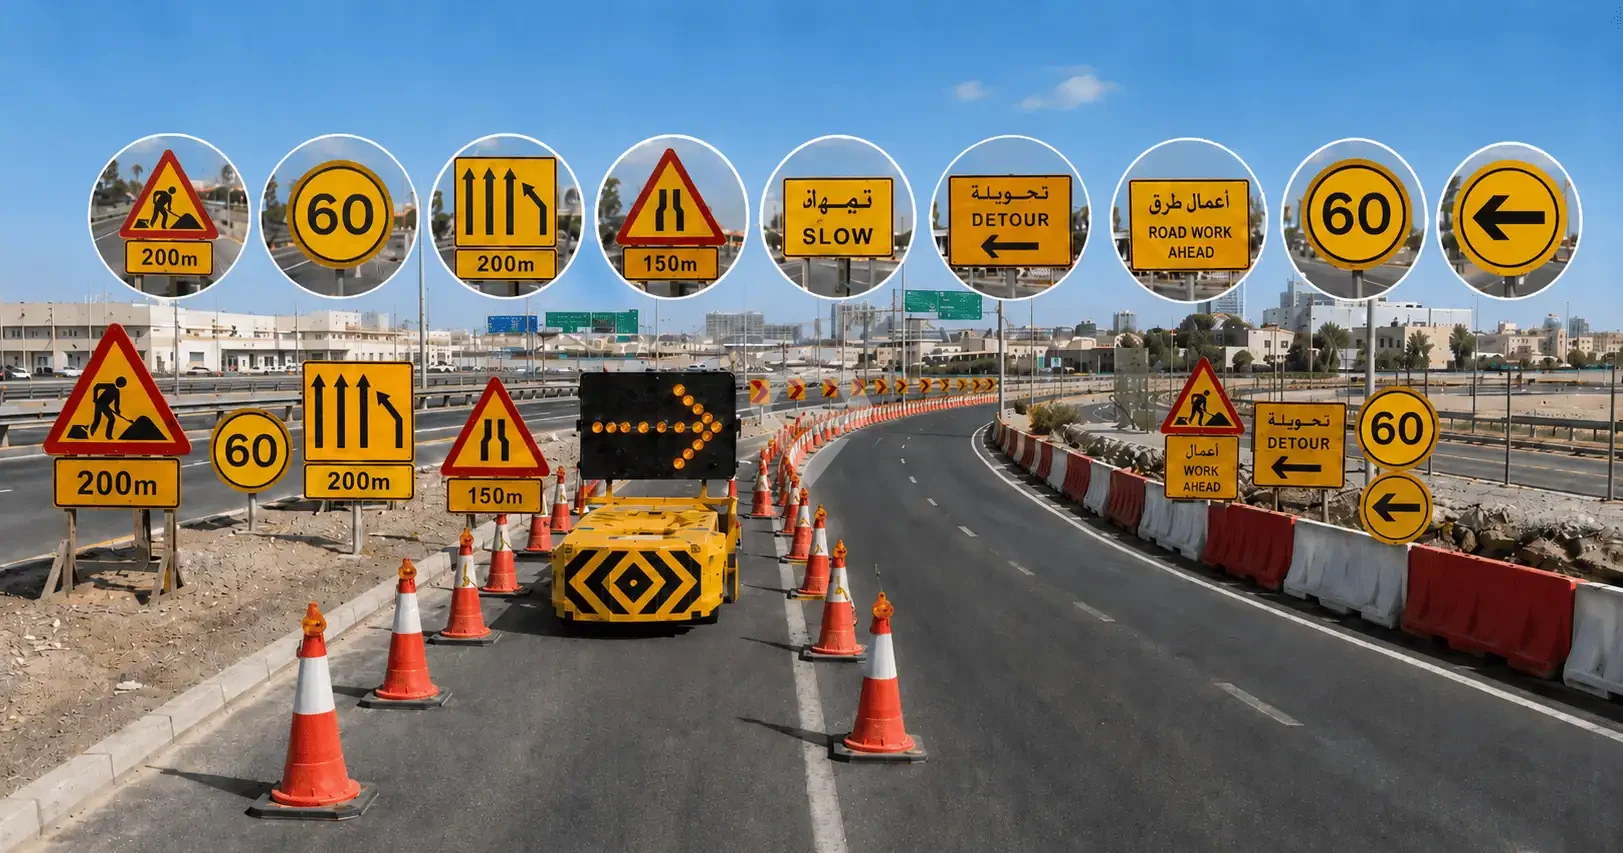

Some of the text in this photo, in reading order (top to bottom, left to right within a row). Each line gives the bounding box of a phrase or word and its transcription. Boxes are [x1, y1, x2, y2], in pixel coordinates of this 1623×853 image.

[971, 184, 1049, 206] تحويلة
[1148, 189, 1230, 216] أعمال طرق
[307, 193, 374, 236] 60
[972, 212, 1049, 227] DETOUR
[1322, 191, 1391, 236] 60
[802, 227, 874, 246] SLOW
[1148, 225, 1232, 239] ROAD WORK
[141, 247, 198, 267] 200m
[1168, 245, 1215, 259] AHEAD
[477, 254, 534, 273] 200m
[643, 254, 697, 273] 150m
[1267, 411, 1331, 432] تحويلة
[1370, 411, 1424, 446] 60
[225, 433, 278, 468] 60
[1185, 442, 1219, 460] أعمال
[1267, 436, 1330, 450] DETOUR
[1183, 465, 1219, 477] WORK
[77, 469, 157, 496] 200m
[327, 471, 390, 491] 200m
[1183, 481, 1221, 493] AHEAD
[468, 486, 523, 505] 150m
